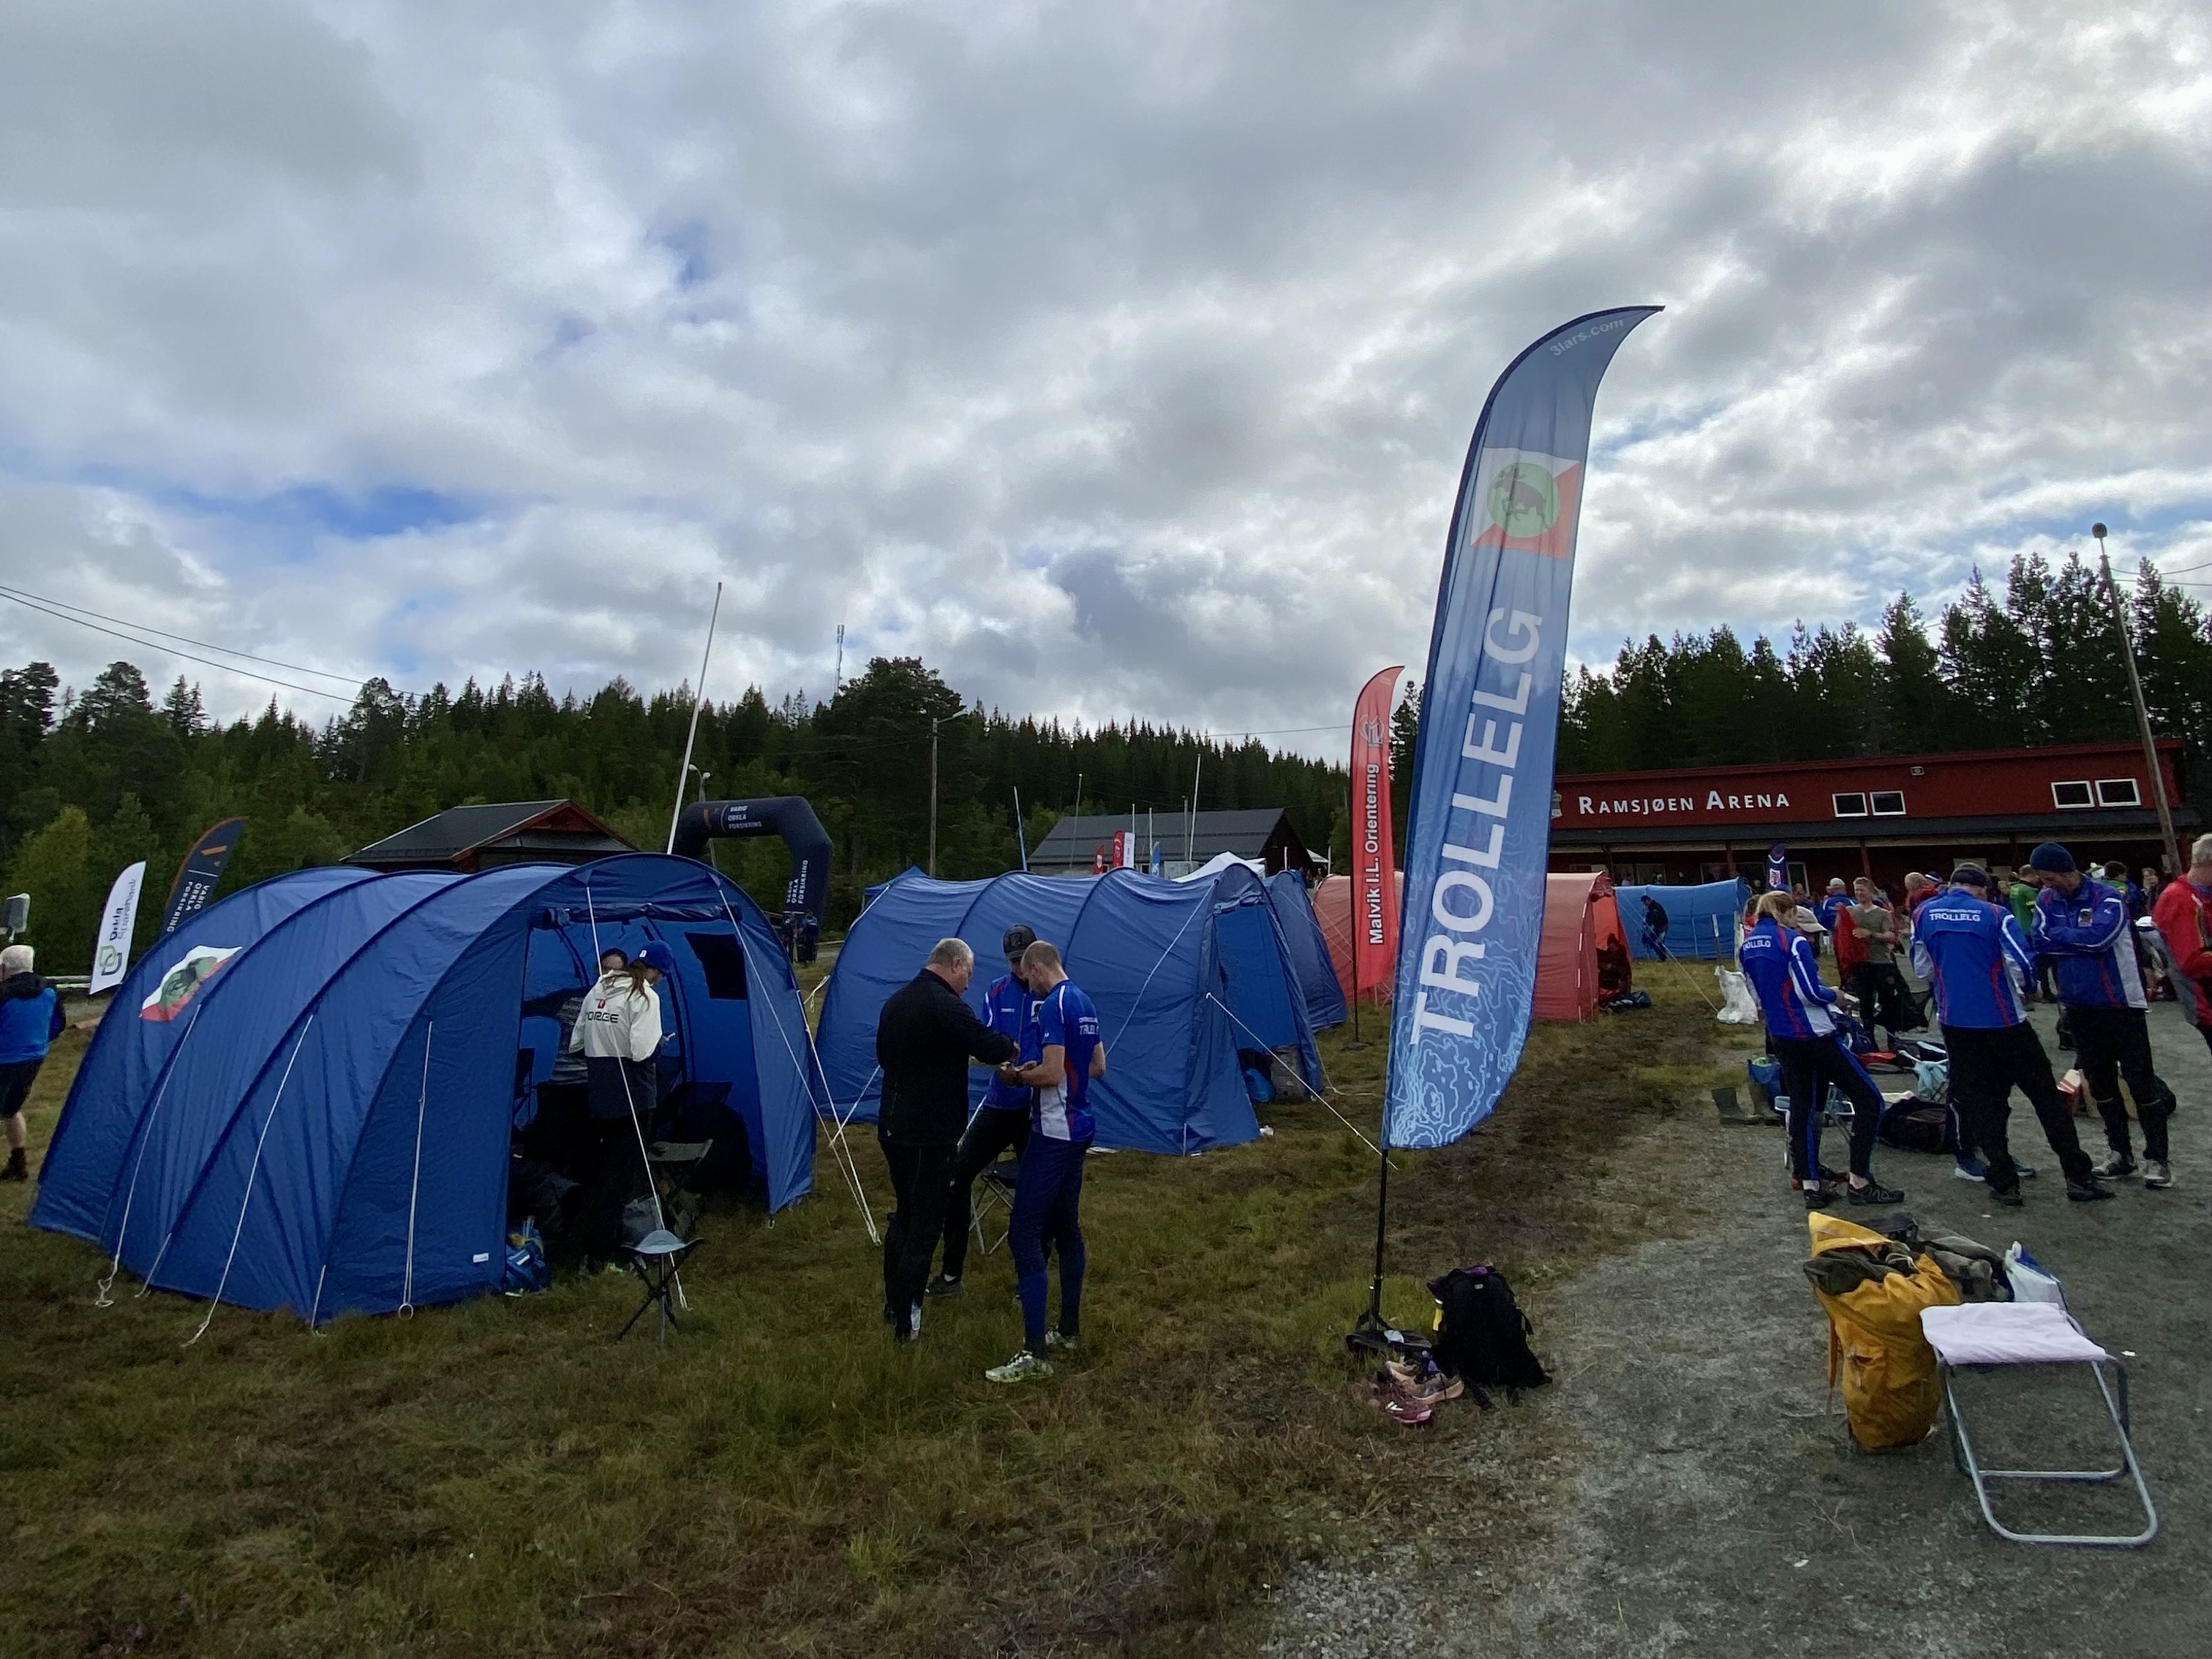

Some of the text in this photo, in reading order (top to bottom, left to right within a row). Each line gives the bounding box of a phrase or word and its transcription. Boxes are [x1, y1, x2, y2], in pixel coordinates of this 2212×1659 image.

[1364, 764, 1380, 854] Orientering
[1410, 606, 1543, 1045] TROLLELG
[791, 879, 799, 904] ORKLA
[798, 859, 808, 904] FORSIKRING
[1365, 857, 1380, 883] I.L.
[1366, 885, 1384, 945] Malvik
[1929, 913, 1981, 922] TROLLELG
